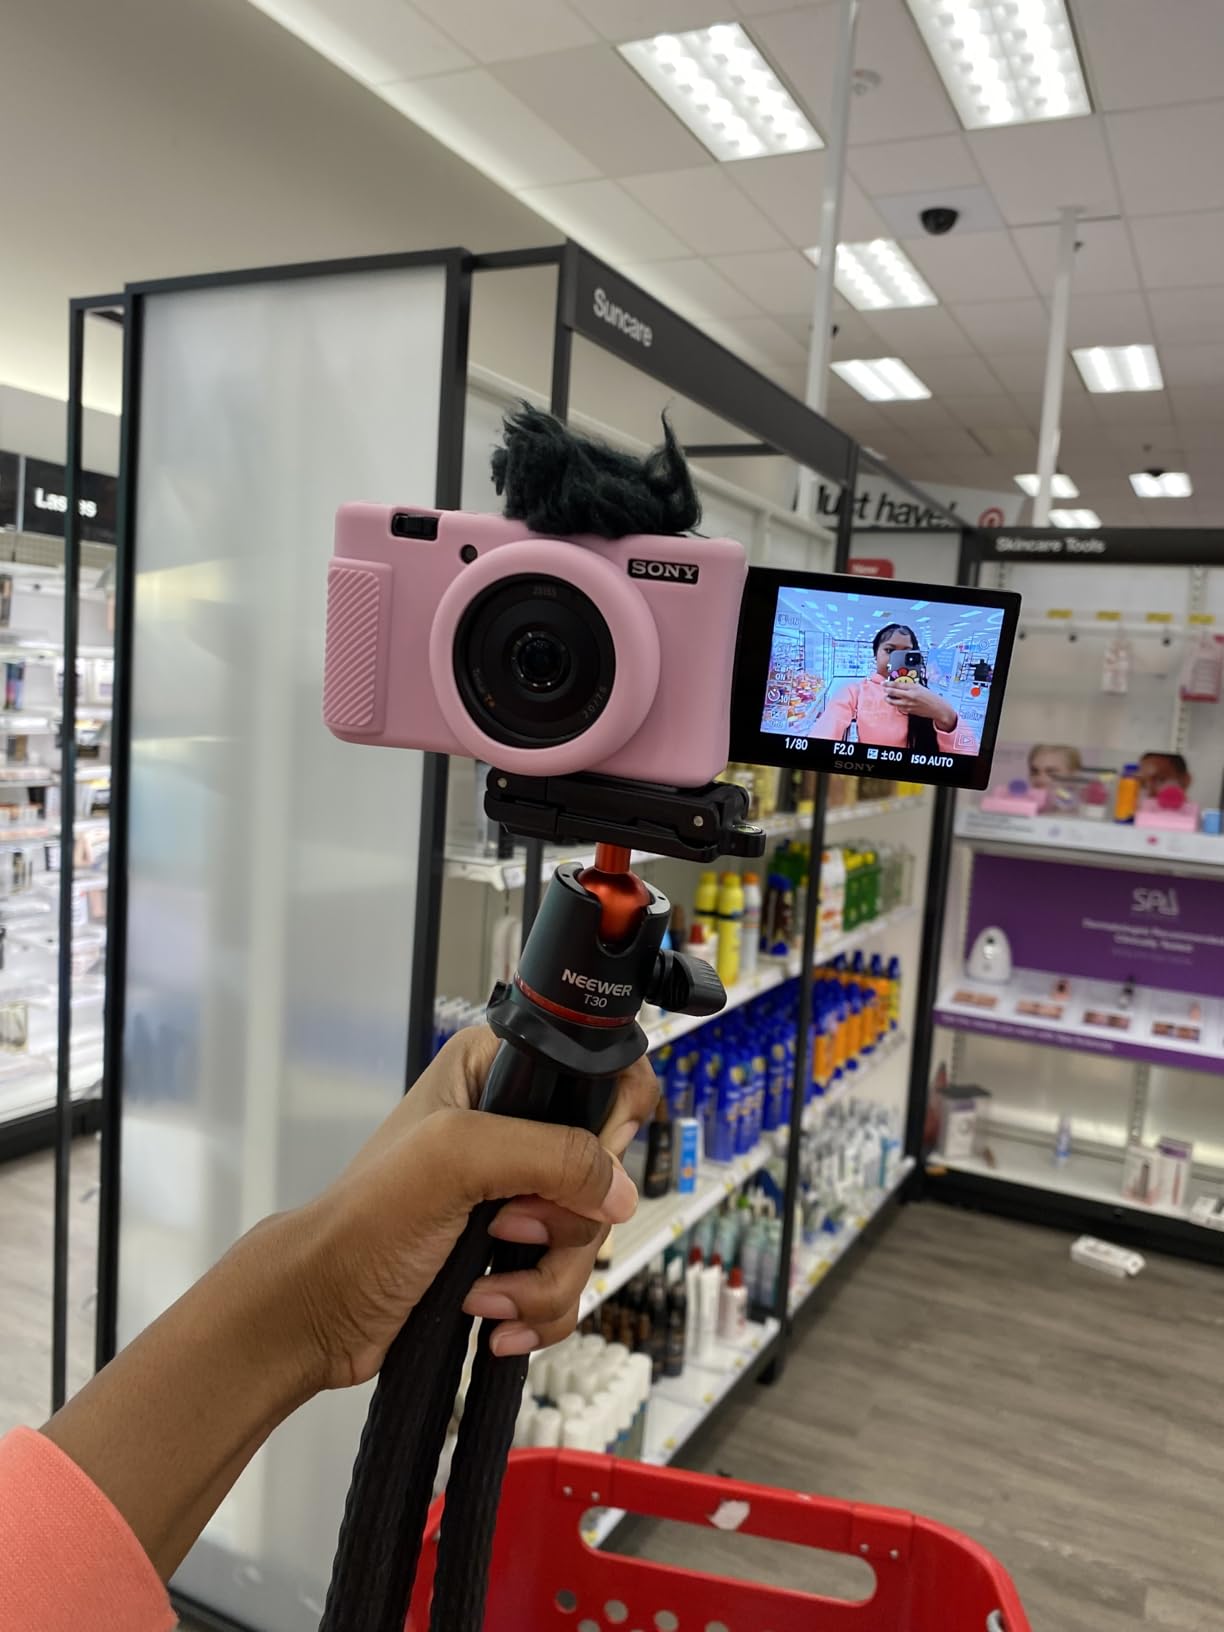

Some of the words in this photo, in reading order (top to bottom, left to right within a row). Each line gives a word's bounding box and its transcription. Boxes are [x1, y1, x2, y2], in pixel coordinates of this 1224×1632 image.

[592, 287, 652, 348] Suncare
[34, 487, 98, 518] Lases
[995, 536, 1063, 552] Skincare
[1064, 536, 1106, 553] Tools
[631, 560, 698, 579] SONY
[784, 737, 809, 751] 1/80
[833, 742, 855, 756] F2.0
[880, 750, 903, 762] ±0.0
[911, 754, 927, 765] ISO
[927, 756, 954, 768] AUTO
[833, 760, 875, 773] SONY
[561, 968, 633, 998] NEEWER
[583, 993, 608, 1009] T30
